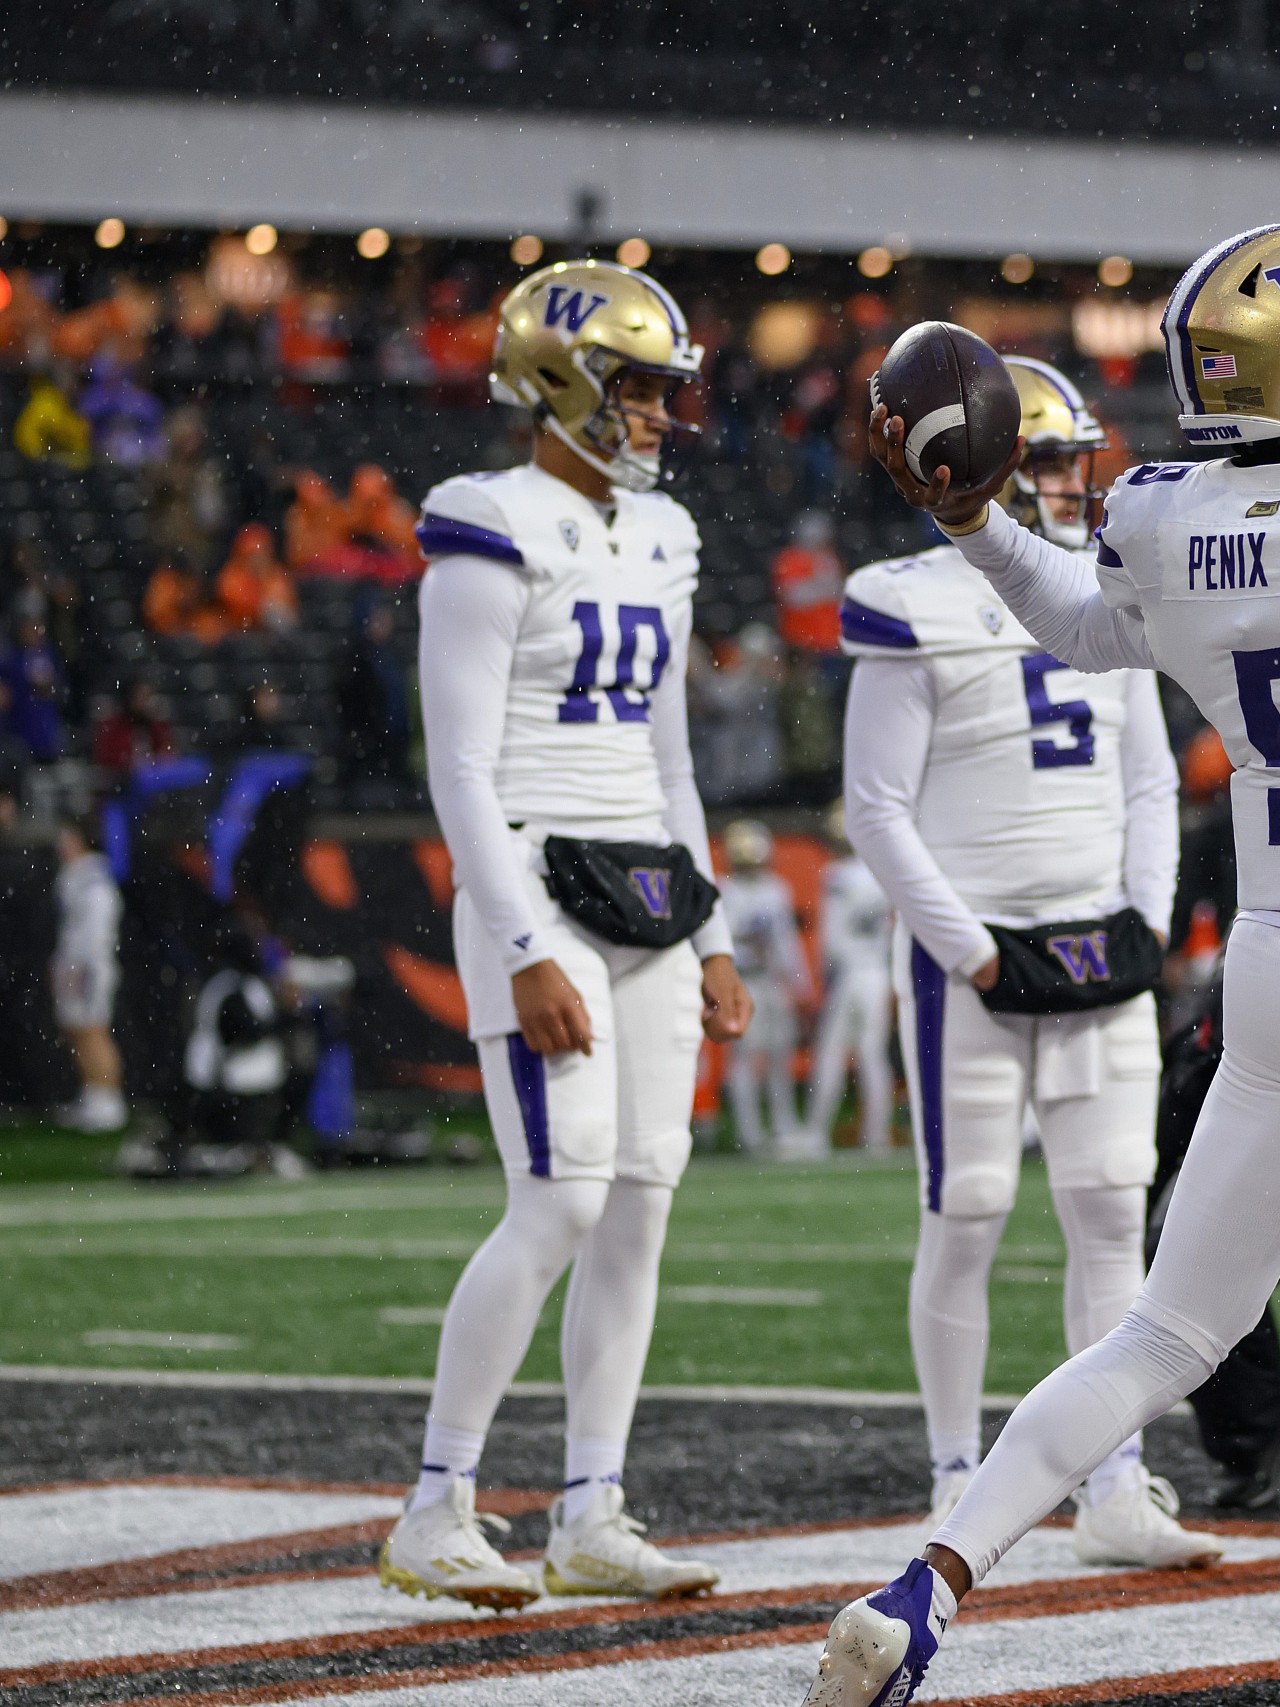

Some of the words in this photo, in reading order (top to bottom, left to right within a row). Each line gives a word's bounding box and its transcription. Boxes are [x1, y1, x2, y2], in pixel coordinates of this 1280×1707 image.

[544, 285, 609, 333] W
[1188, 532, 1268, 590] PENIX
[558, 601, 670, 723] 10
[1021, 653, 1095, 769] 5
[1045, 931, 1111, 985] W
